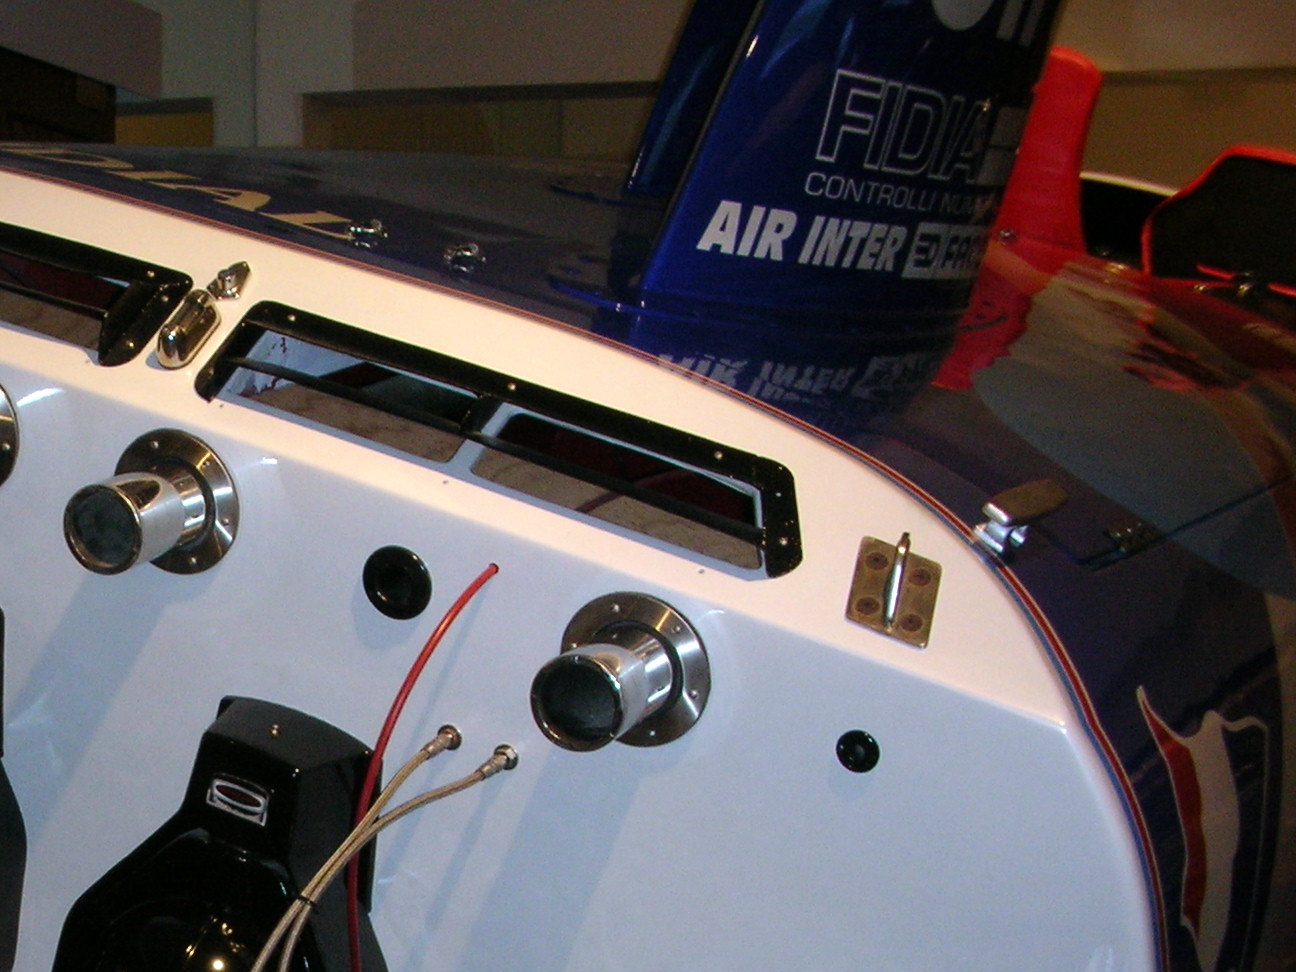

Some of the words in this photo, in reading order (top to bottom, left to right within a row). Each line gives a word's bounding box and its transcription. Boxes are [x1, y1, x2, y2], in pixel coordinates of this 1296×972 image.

[815, 68, 990, 184] FIDIA
[804, 172, 936, 212] CONTROLLI
[697, 200, 797, 262] AIR
[798, 216, 908, 273] INTER
